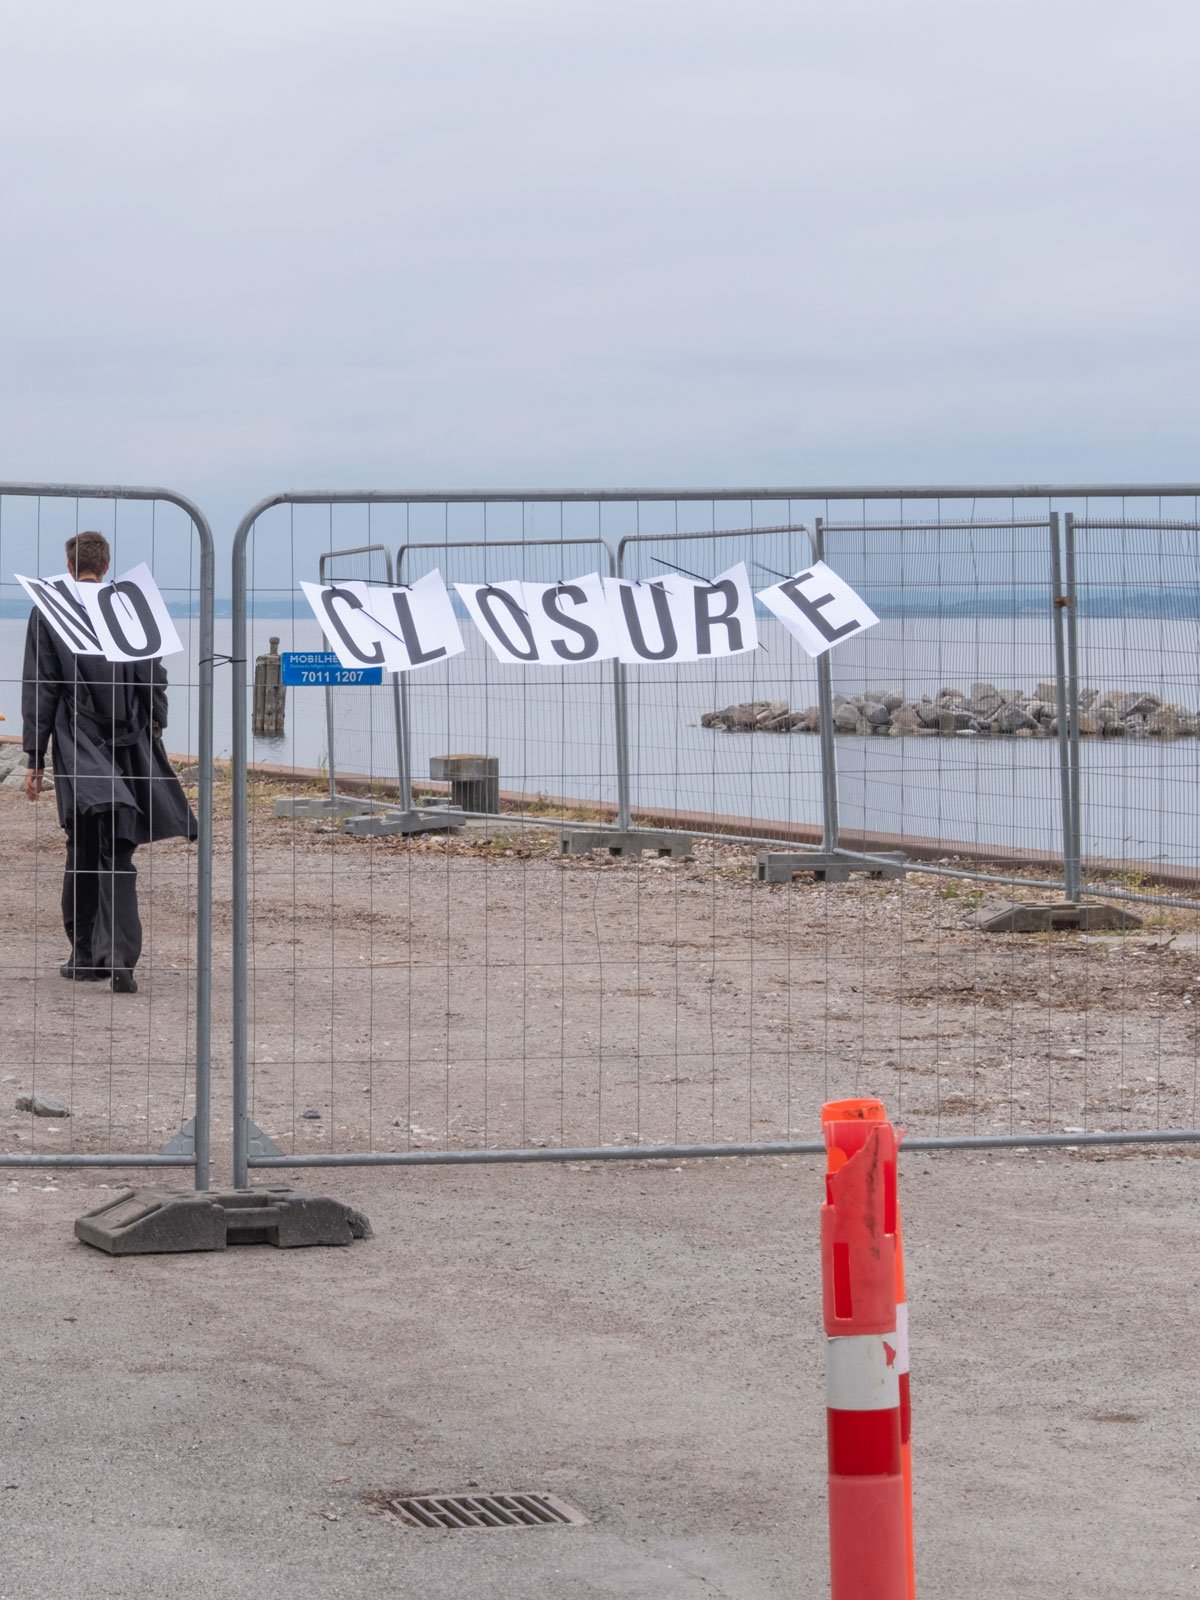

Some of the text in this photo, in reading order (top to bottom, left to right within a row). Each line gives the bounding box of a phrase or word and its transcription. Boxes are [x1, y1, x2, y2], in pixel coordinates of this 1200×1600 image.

[27, 579, 162, 658] NO
[320, 572, 862, 666] CLOSURE
[290, 655, 342, 664] MOBILHE
[301, 671, 364, 683] 7011 1207
